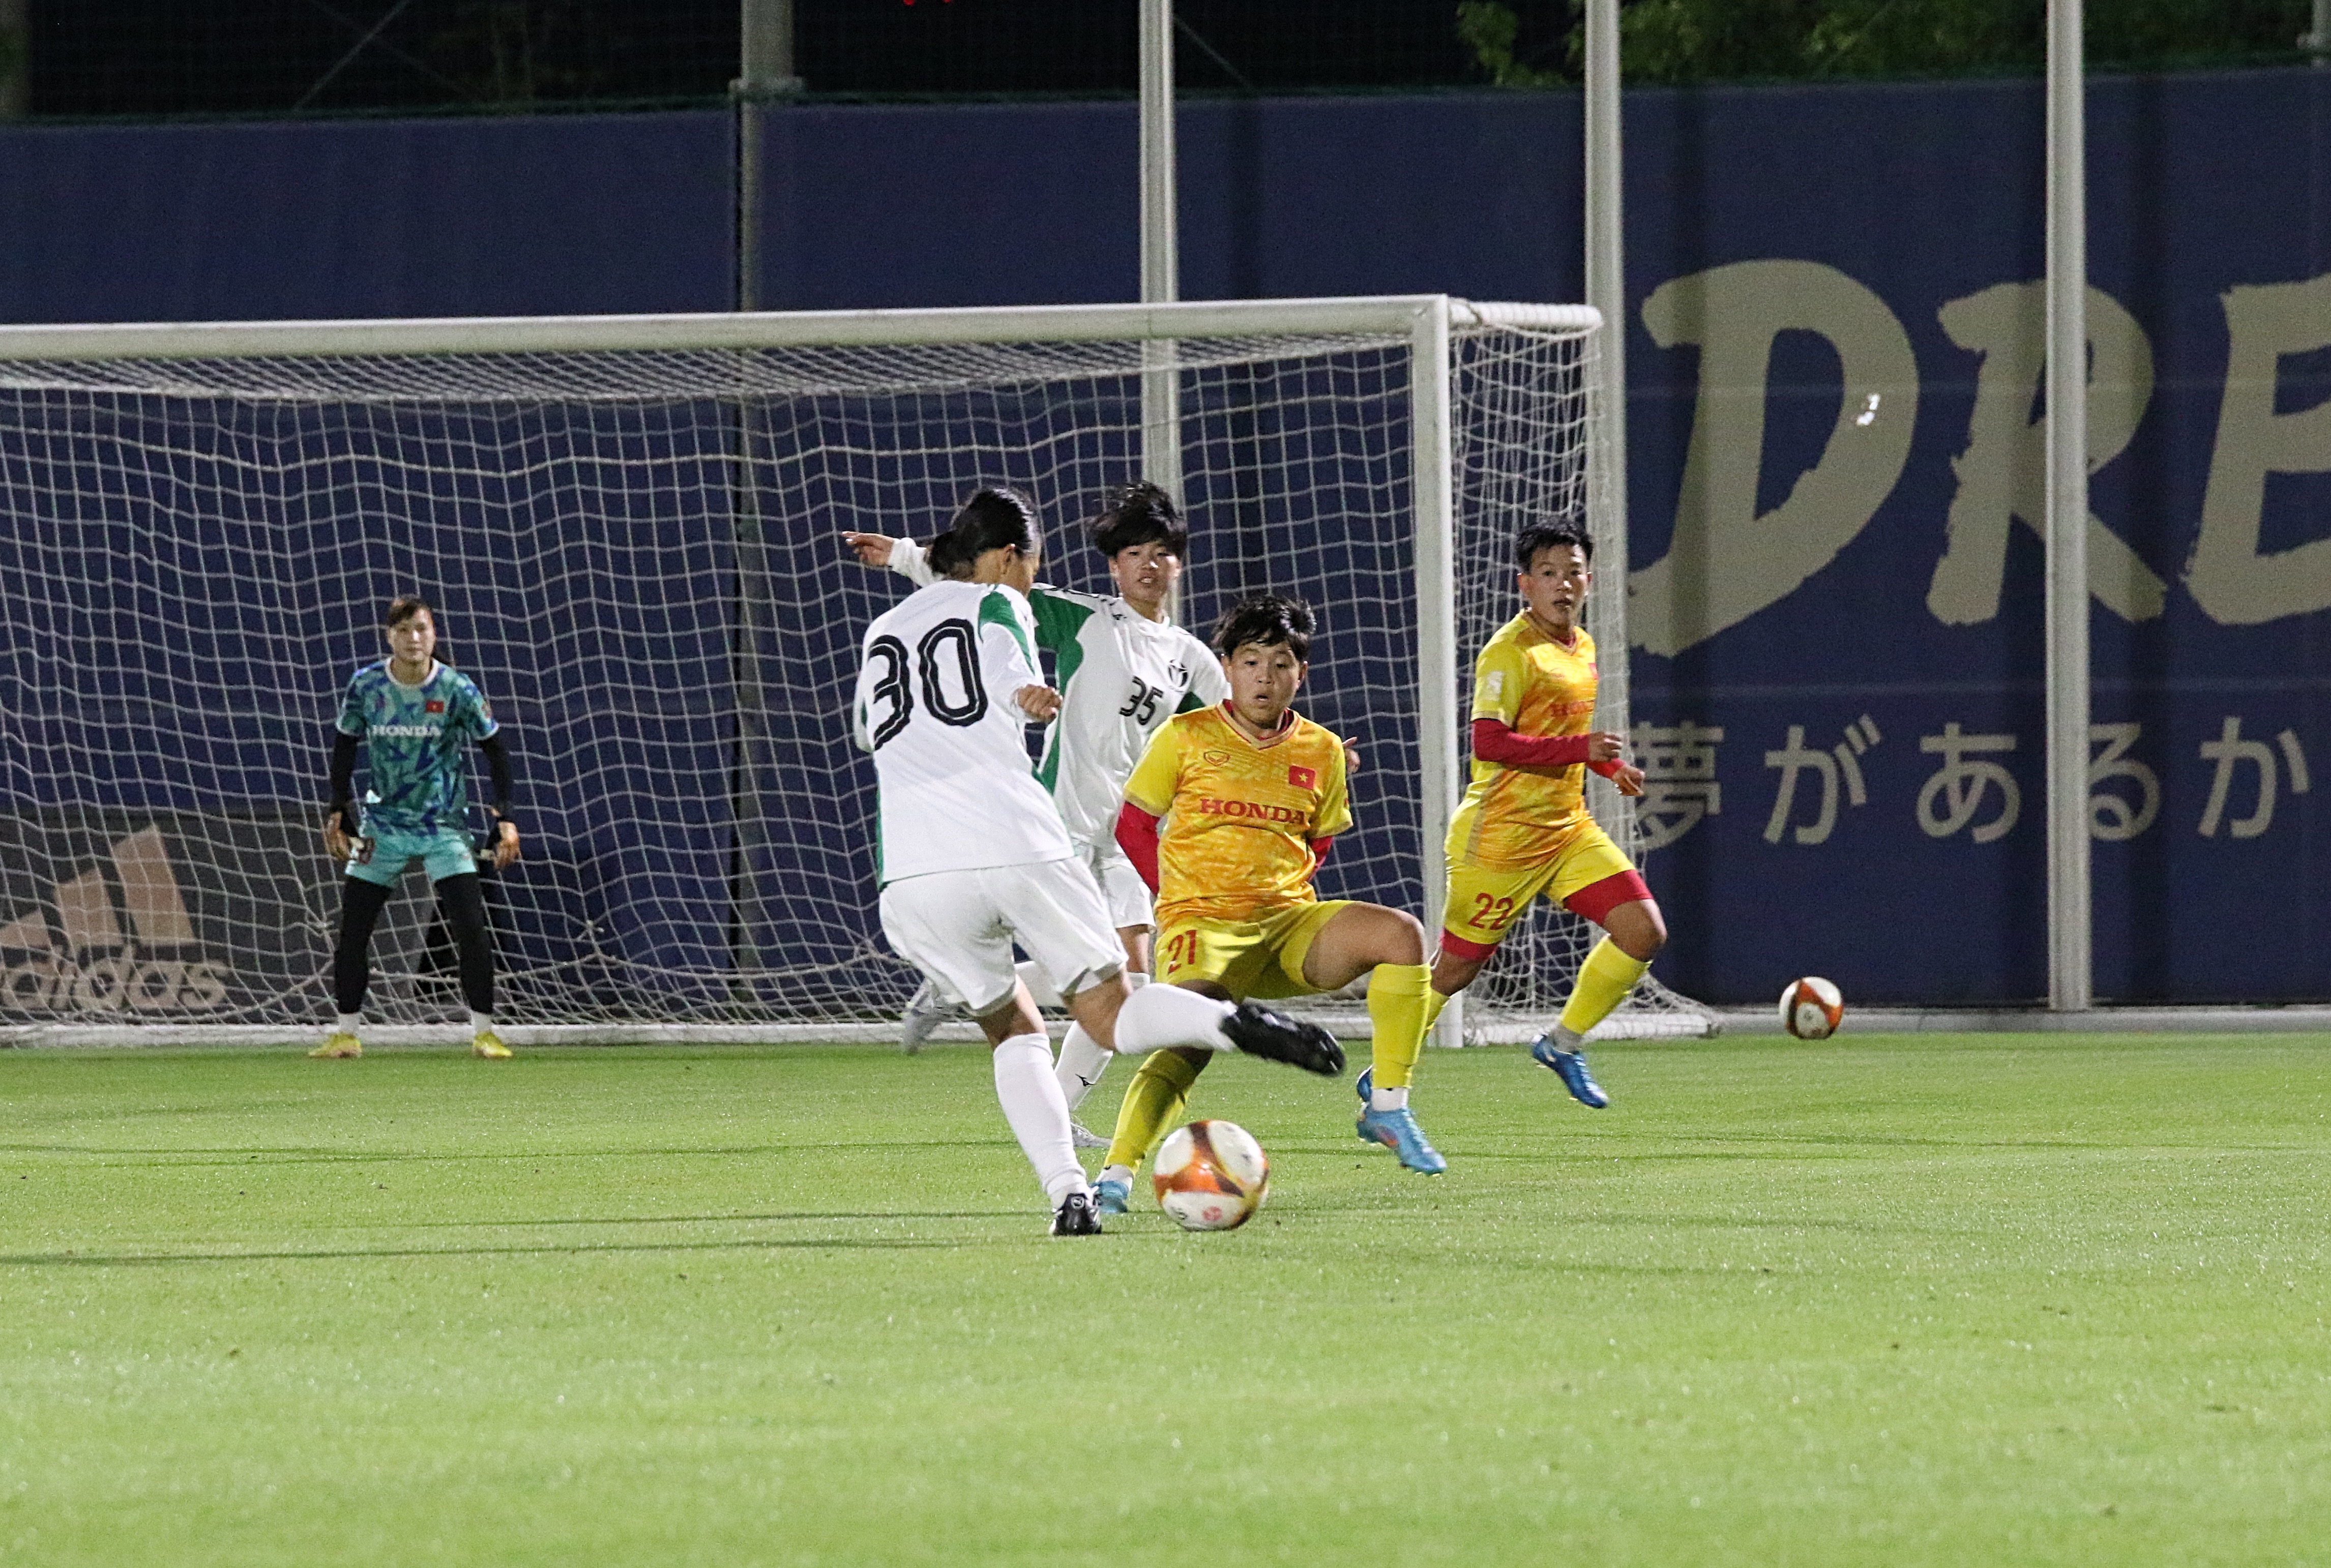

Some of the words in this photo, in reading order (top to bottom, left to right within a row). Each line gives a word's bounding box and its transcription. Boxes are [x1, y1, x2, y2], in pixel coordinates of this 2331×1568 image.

[866, 617, 988, 751] 30
[1119, 675, 1164, 726] 35
[372, 724, 442, 737] HONDA
[1199, 798, 1306, 824] HONDA
[1468, 893, 1514, 929] 22
[1168, 930, 1197, 974] 21
[0, 944, 227, 1013] adidas
